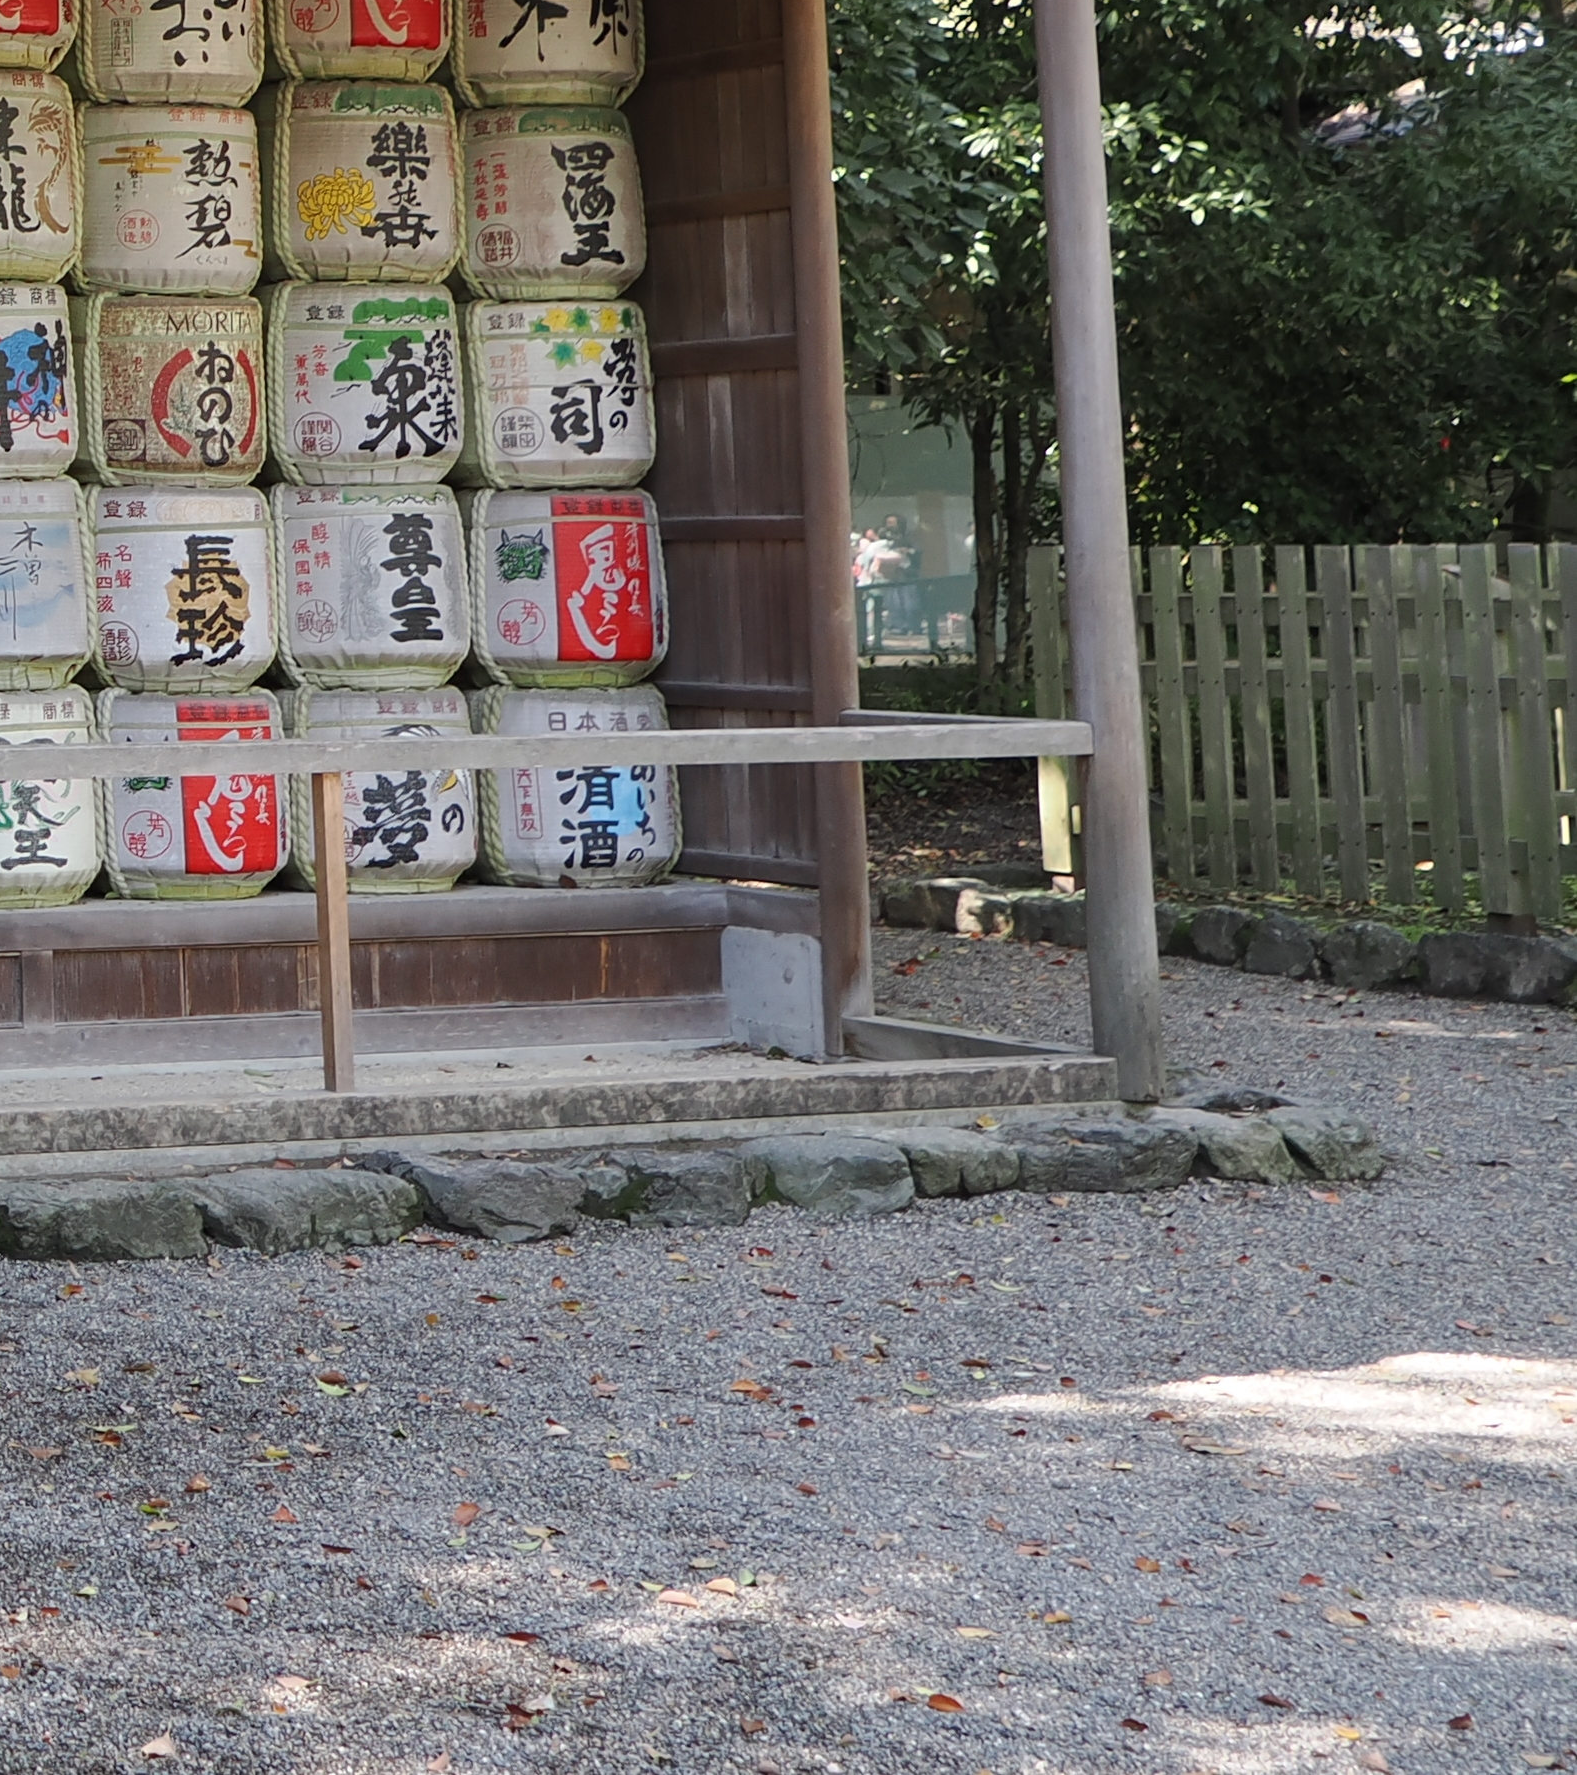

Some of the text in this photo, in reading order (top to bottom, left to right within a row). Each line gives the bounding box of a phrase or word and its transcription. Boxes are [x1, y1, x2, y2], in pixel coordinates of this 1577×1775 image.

[12, 73, 45, 89] 商標
[551, 141, 625, 267] 四海王
[306, 306, 345, 321] 登録
[488, 313, 525, 330] 登録
[194, 341, 235, 467] ねのひ
[550, 380, 603, 454] 司
[104, 501, 147, 519] 登録
[171, 534, 245, 666] 長珍
[380, 513, 442, 642] 尊皇
[567, 524, 626, 659] 鬼ころし
[501, 602, 539, 643] 芳醇
[126, 815, 163, 858] 芳醇
[556, 767, 619, 868] 清酒
